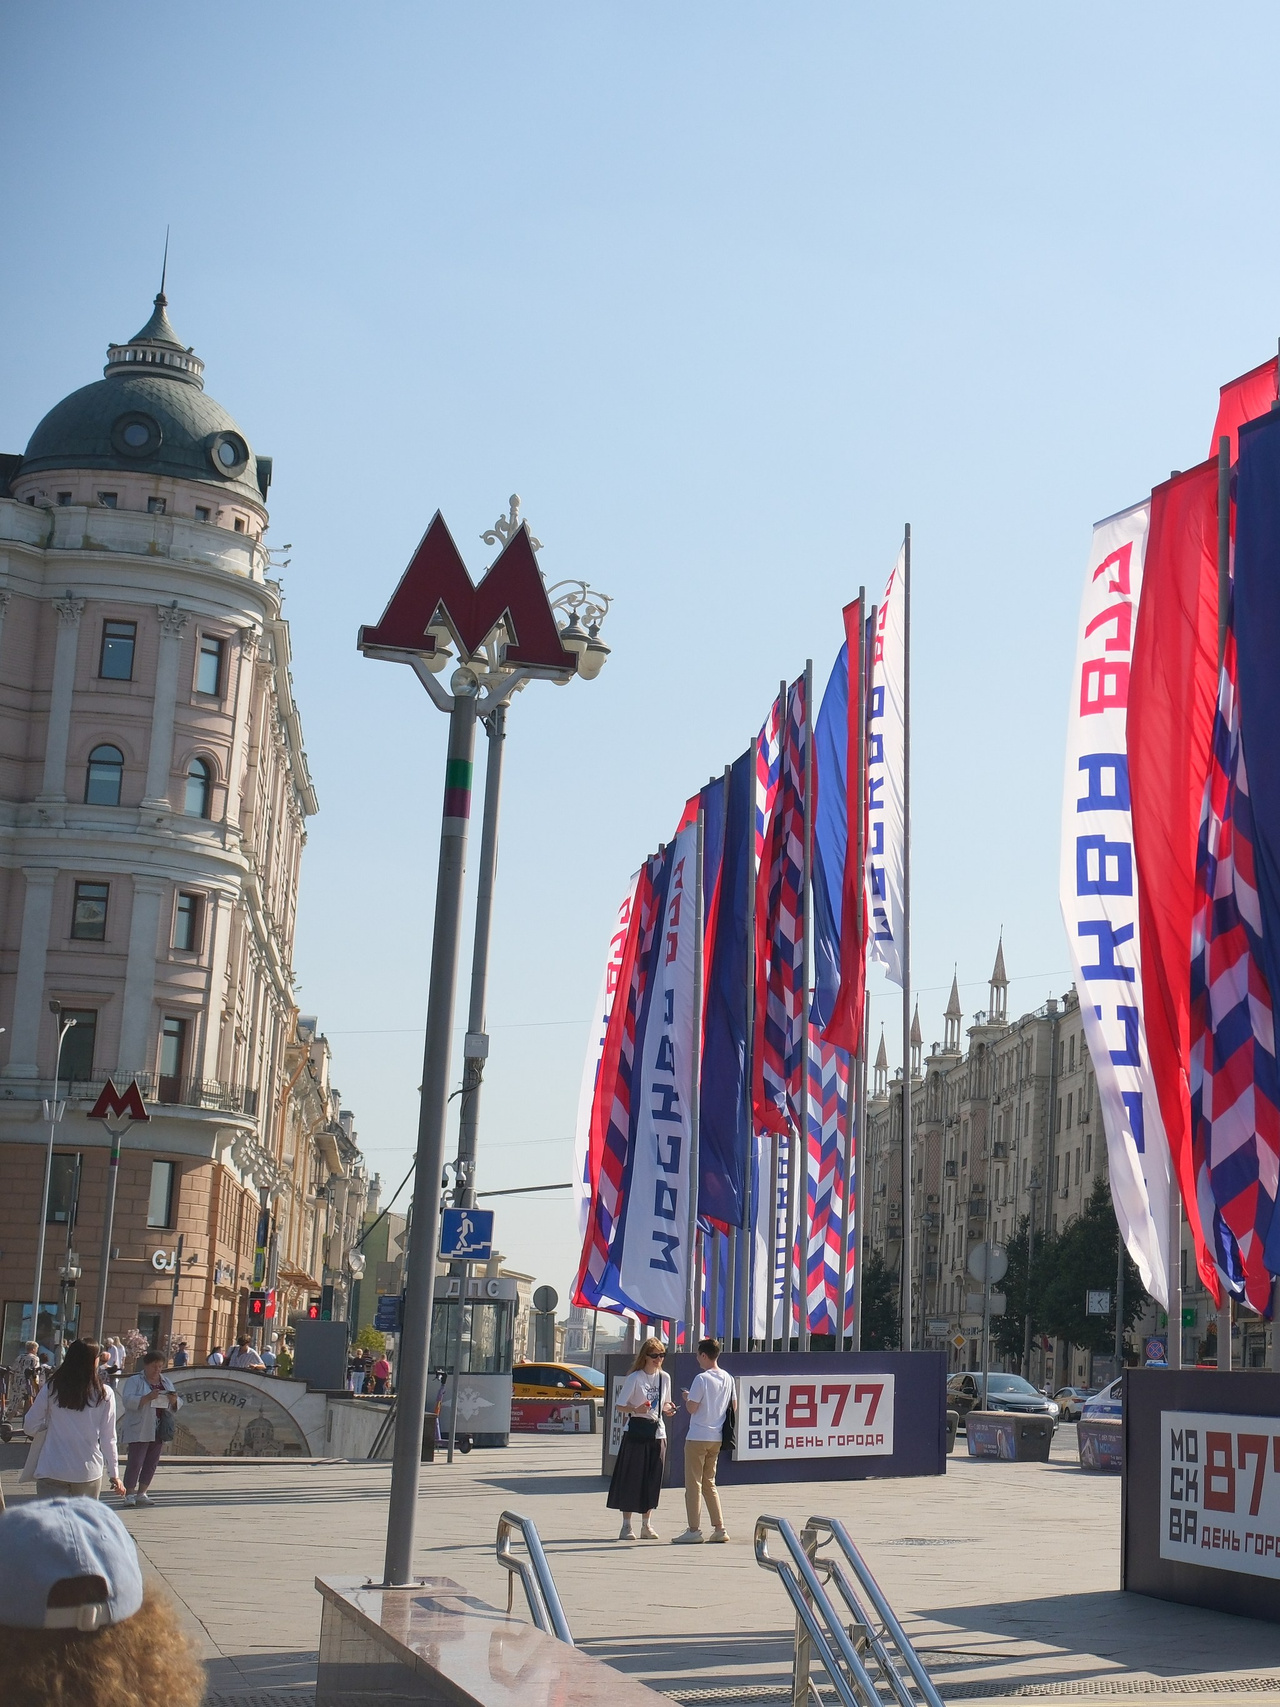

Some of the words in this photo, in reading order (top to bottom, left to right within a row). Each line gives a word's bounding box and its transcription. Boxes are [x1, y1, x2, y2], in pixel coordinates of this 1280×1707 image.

[446, 1278, 500, 1298] ДПС
[749, 1385, 781, 1405] МО
[785, 1383, 885, 1428] 877
[748, 1406, 780, 1426] СК
[748, 1429, 780, 1449] ВА
[784, 1435, 824, 1450] ДЕНЬ
[827, 1433, 884, 1447] ГОРОДА
[1170, 1428, 1199, 1463] МО
[1170, 1466, 1199, 1503] СК
[1169, 1507, 1198, 1545] ВА
[1201, 1525, 1241, 1552] ДЕНЬ
